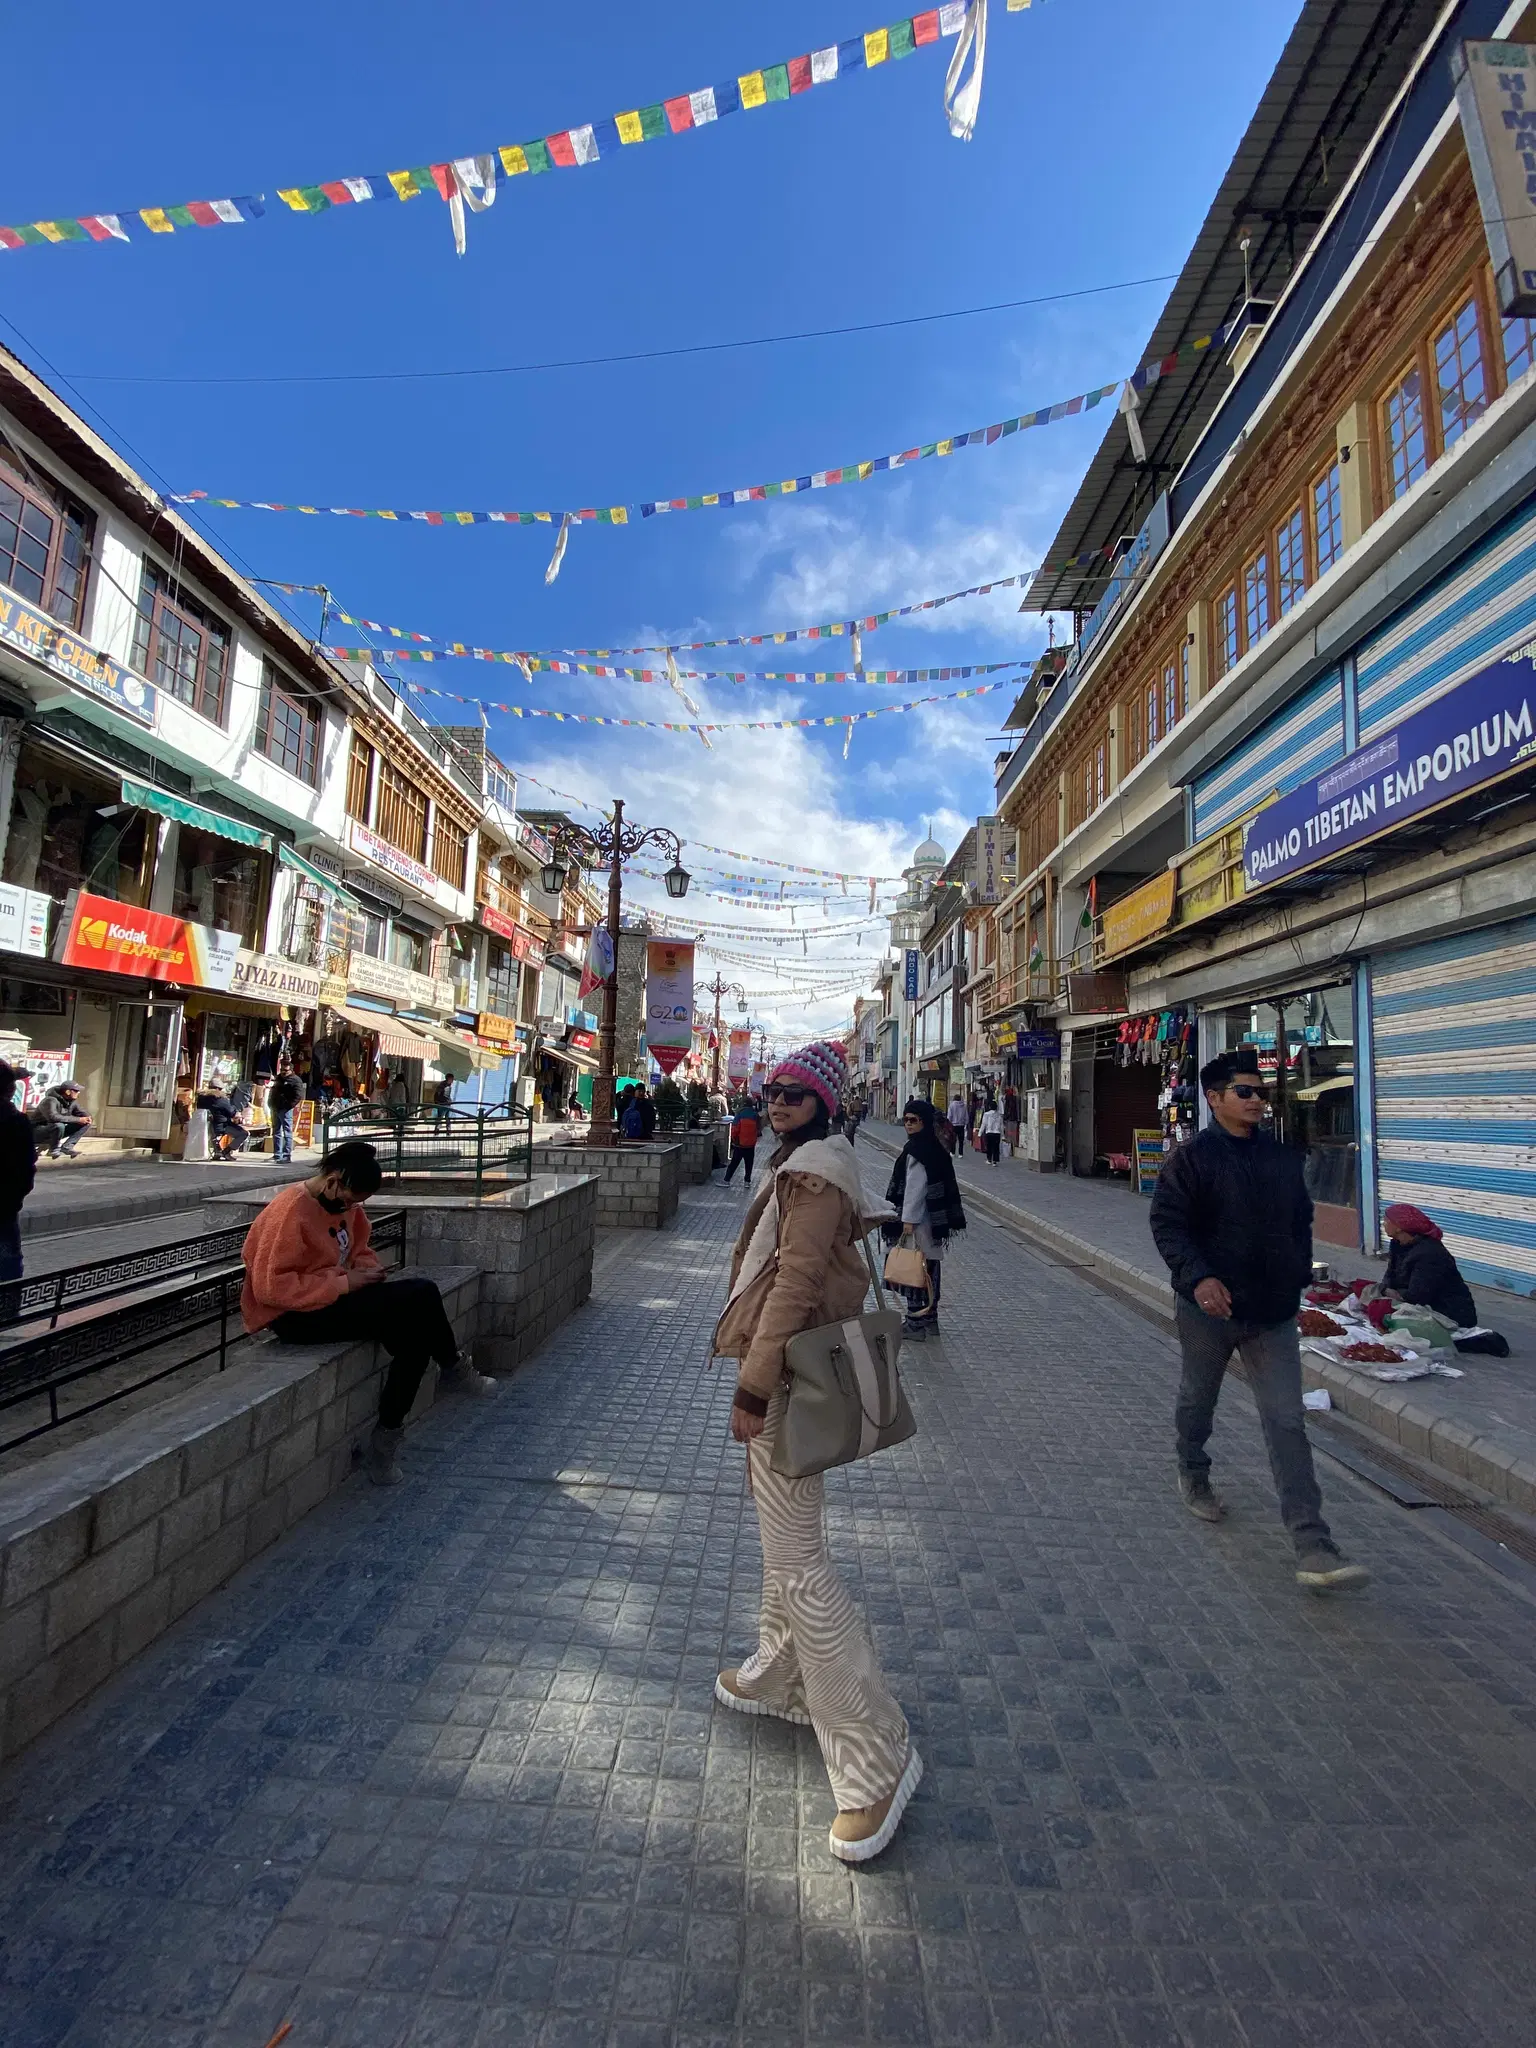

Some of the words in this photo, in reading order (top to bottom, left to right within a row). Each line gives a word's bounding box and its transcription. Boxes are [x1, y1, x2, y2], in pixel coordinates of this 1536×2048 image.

[15, 610, 120, 688] KITCHEN
[1251, 827, 1301, 877] PALMO
[1304, 784, 1377, 848] TIBETAN
[1382, 698, 1534, 810] EMPORIUM
[313, 853, 340, 874] CLINIC
[357, 825, 387, 852] TIBETAN
[387, 847, 413, 870] FRIENDS
[413, 862, 437, 886] CORNER
[371, 848, 425, 888] RESTAURANT
[984, 828, 996, 895] HIMALAYAN
[108, 923, 147, 945] Kodak
[118, 939, 185, 965] EXPRESS
[233, 962, 277, 988] RIYAZ
[278, 973, 319, 997] AHMED
[649, 1004, 688, 1021] G20
